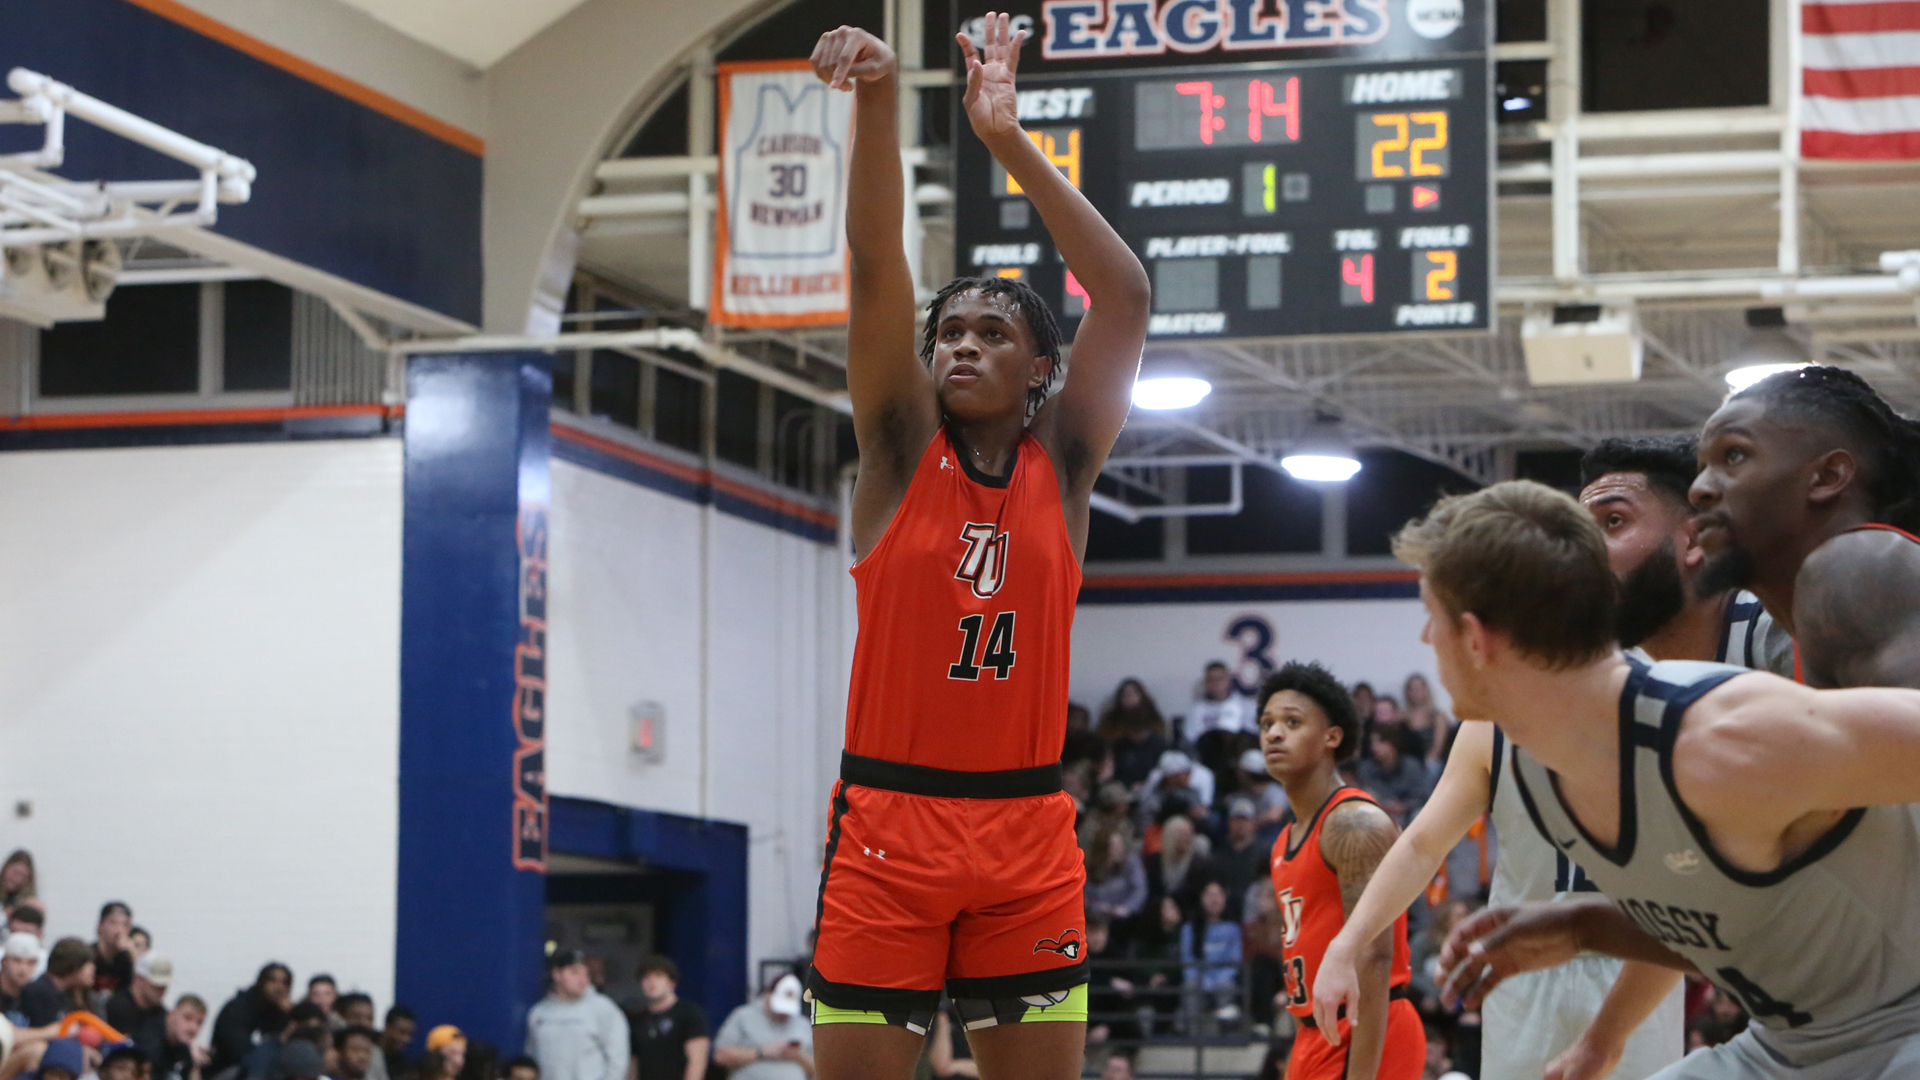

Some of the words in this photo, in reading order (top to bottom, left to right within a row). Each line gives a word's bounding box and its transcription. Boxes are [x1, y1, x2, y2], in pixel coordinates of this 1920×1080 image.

[1042, 0, 1390, 59] EAGLES
[1351, 69, 1454, 104] HOME
[1017, 88, 1094, 121] EST
[1175, 76, 1299, 145] 7:14
[757, 133, 822, 158] CARSON
[1372, 111, 1448, 178] 22
[769, 164, 807, 198] 30
[1130, 178, 1230, 208] PERIOD
[1262, 163, 1277, 213] 1
[751, 202, 823, 226] NEWMAN
[1335, 228, 1378, 251] TOL
[1400, 224, 1470, 249] FOULS
[972, 243, 1041, 266] FOULS
[1342, 253, 1375, 303] 4
[1426, 250, 1458, 300] 2
[1148, 312, 1227, 334] MATCH
[1396, 301, 1476, 327] POINTS
[954, 521, 1010, 599] TU
[947, 611, 1017, 681] 14
[1222, 611, 1277, 699] 3
